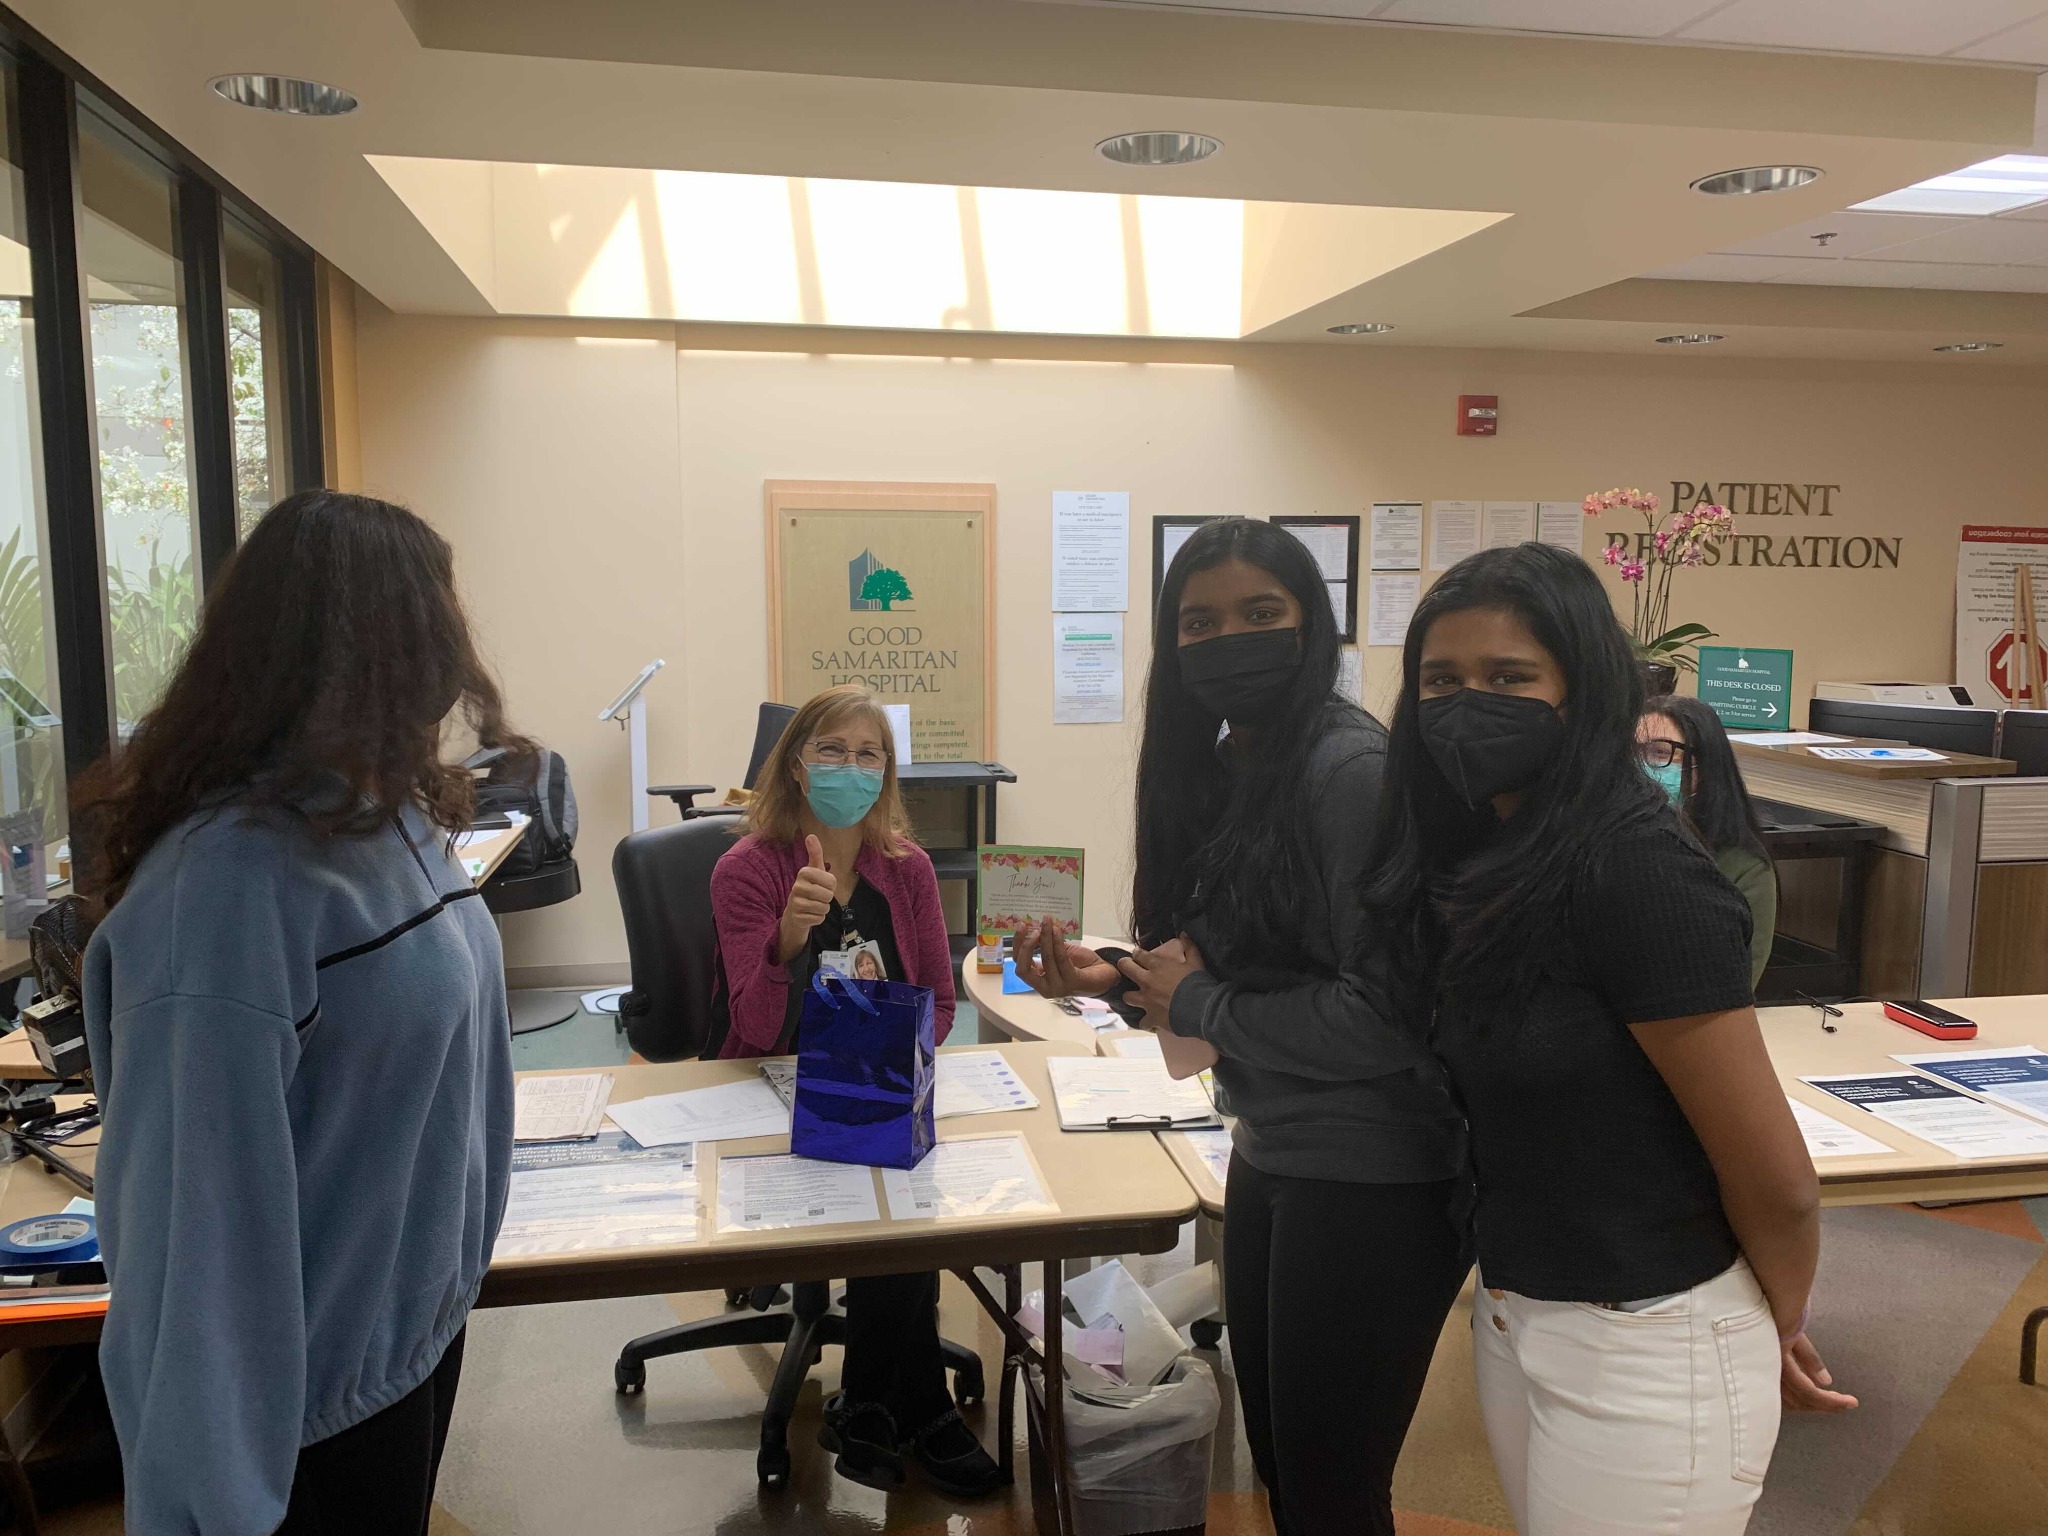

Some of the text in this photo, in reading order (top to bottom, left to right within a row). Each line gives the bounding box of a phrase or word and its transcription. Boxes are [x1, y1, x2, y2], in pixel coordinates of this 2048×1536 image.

[1670, 481, 1841, 517] PATIENT
[1968, 529, 2013, 538] cooperation
[1605, 532, 1904, 569] RESTRATION
[848, 626, 922, 646] GOOD
[811, 650, 958, 670] SAMARITAN
[831, 674, 941, 693] HOSPITAL
[1706, 679, 1723, 687] THIS
[1723, 681, 1742, 689] DESK
[1751, 683, 1782, 692] CLOSED
[926, 718, 936, 726] the
[939, 718, 956, 726] basic
[929, 729, 965, 737] committed
[947, 751, 963, 759] total
[1006, 871, 1031, 892] Thank
